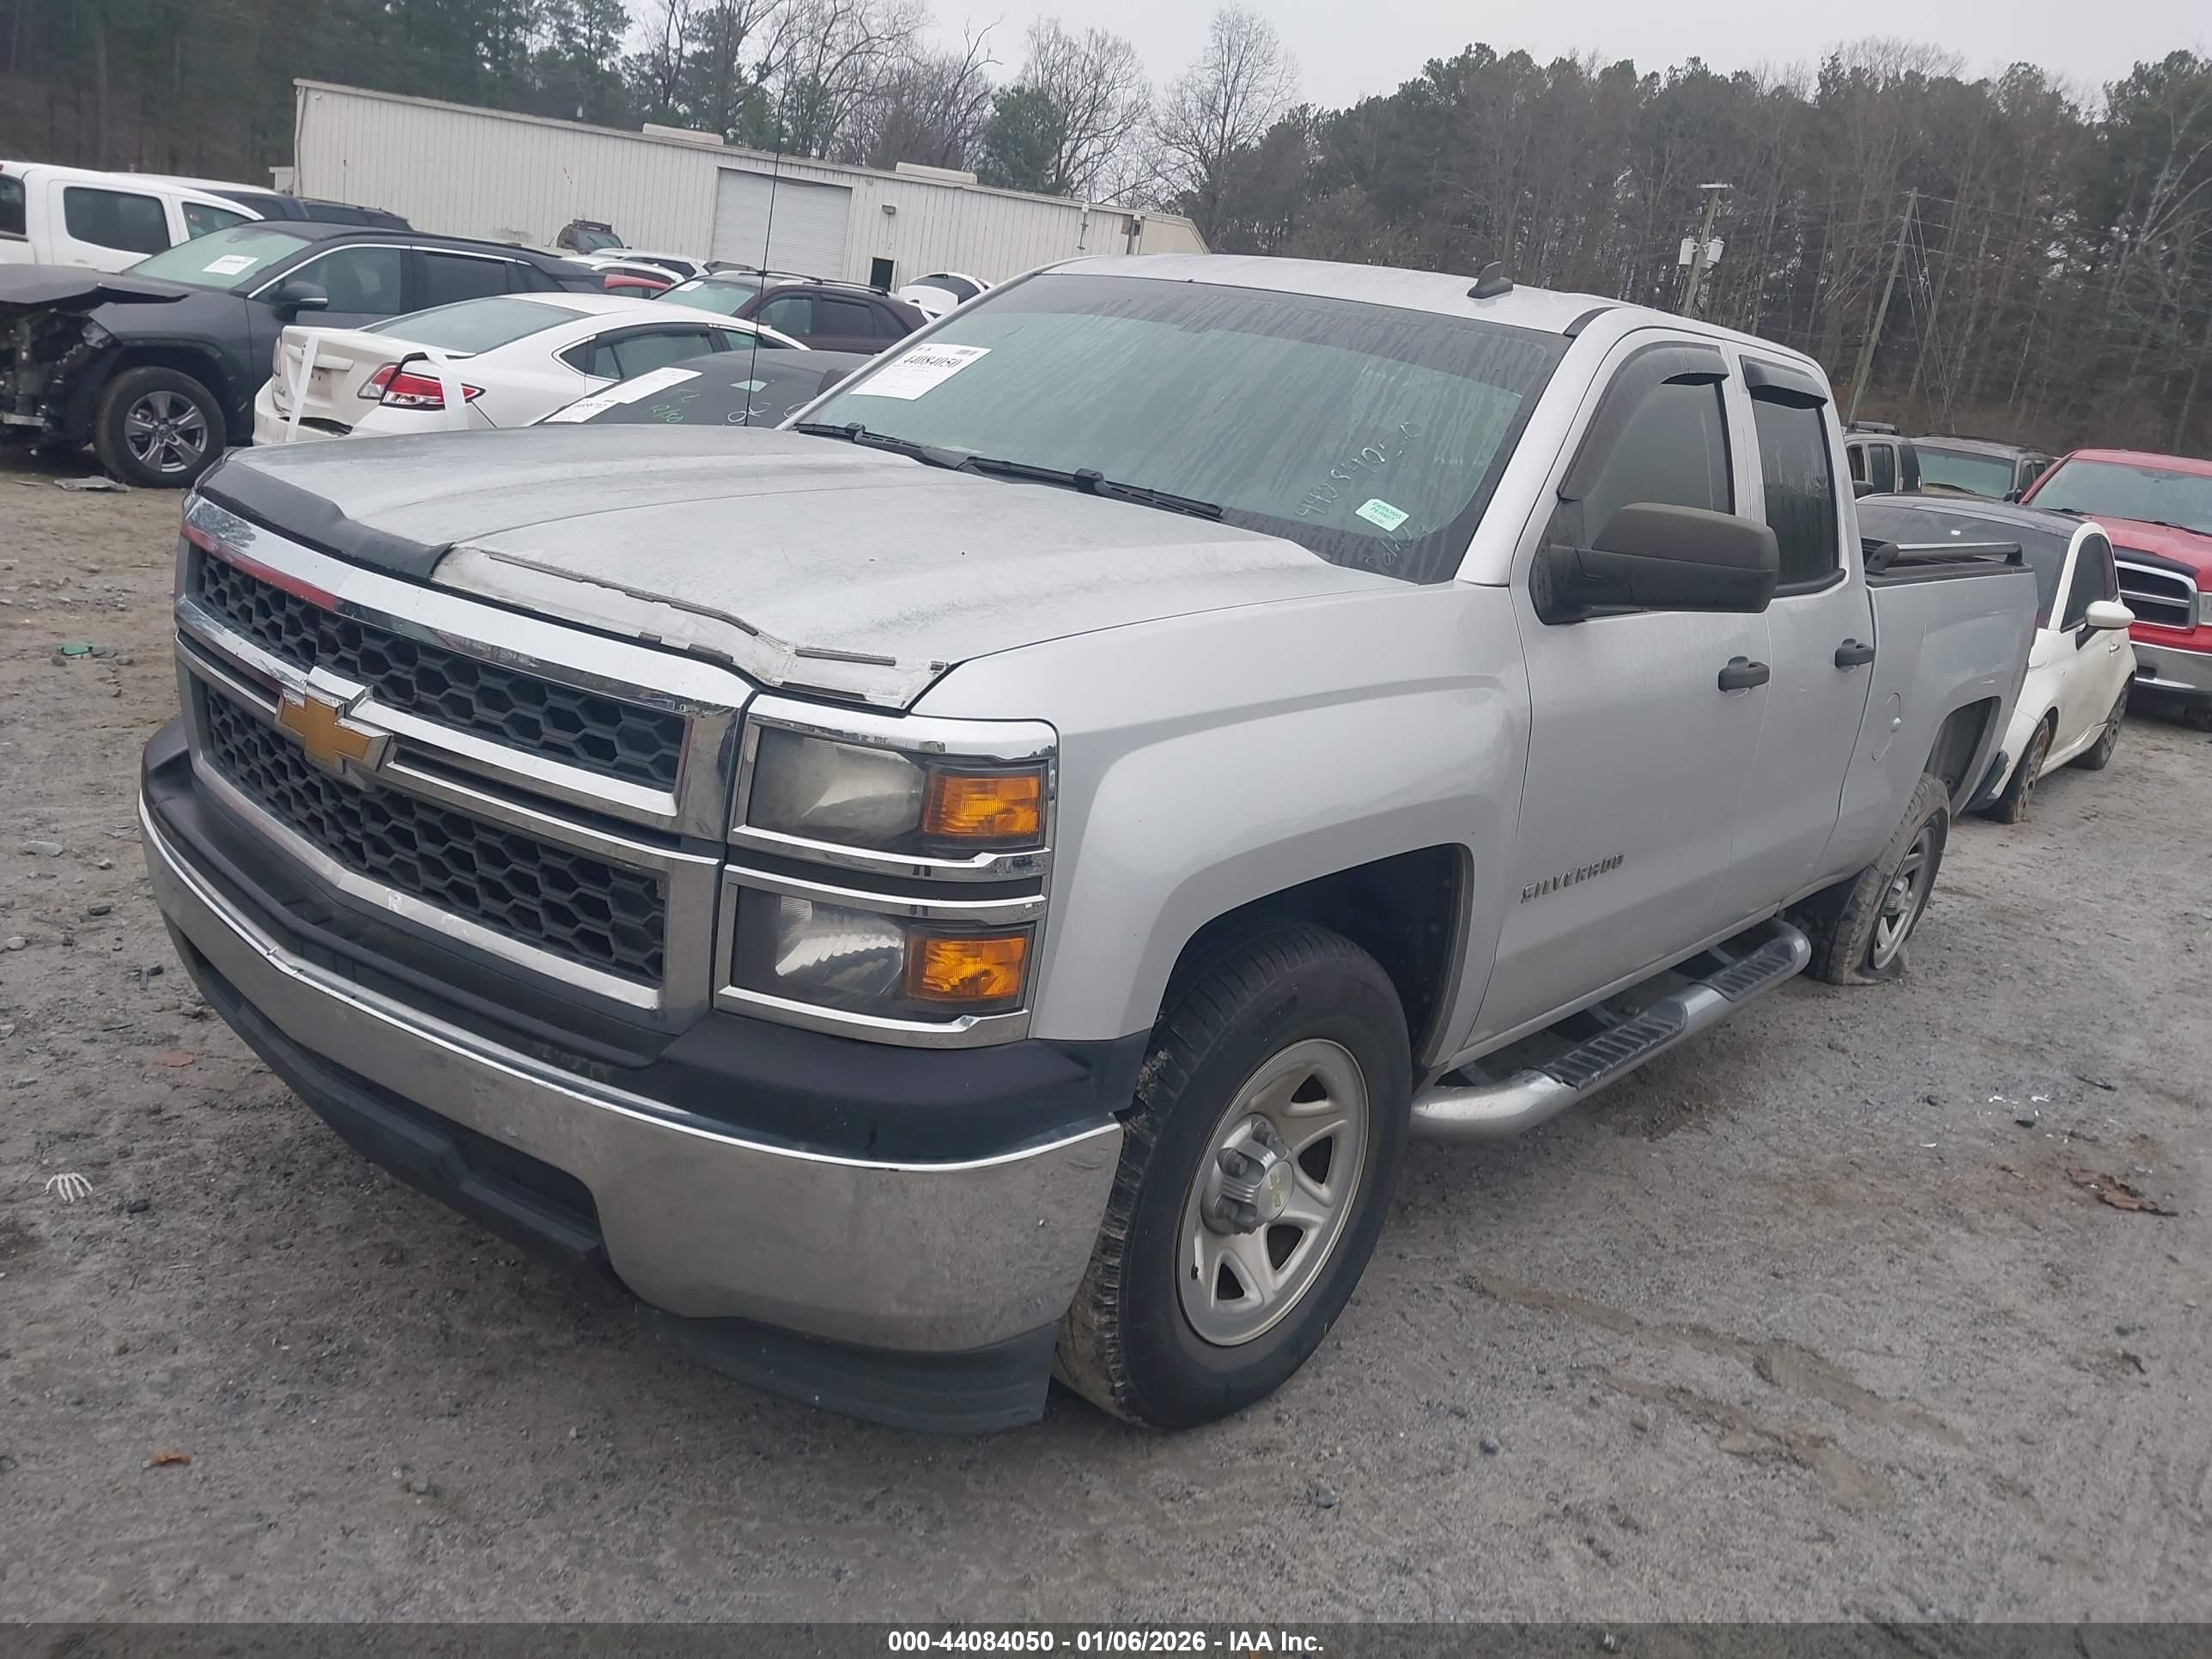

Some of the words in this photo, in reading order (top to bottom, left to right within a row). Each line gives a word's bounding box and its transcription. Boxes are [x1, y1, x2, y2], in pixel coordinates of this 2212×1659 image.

[902, 354, 963, 368] 44084050
[1370, 507, 1396, 522] PERMIT
[1371, 501, 1402, 520] PARKING
[1520, 852, 1625, 904] SILVERADO
